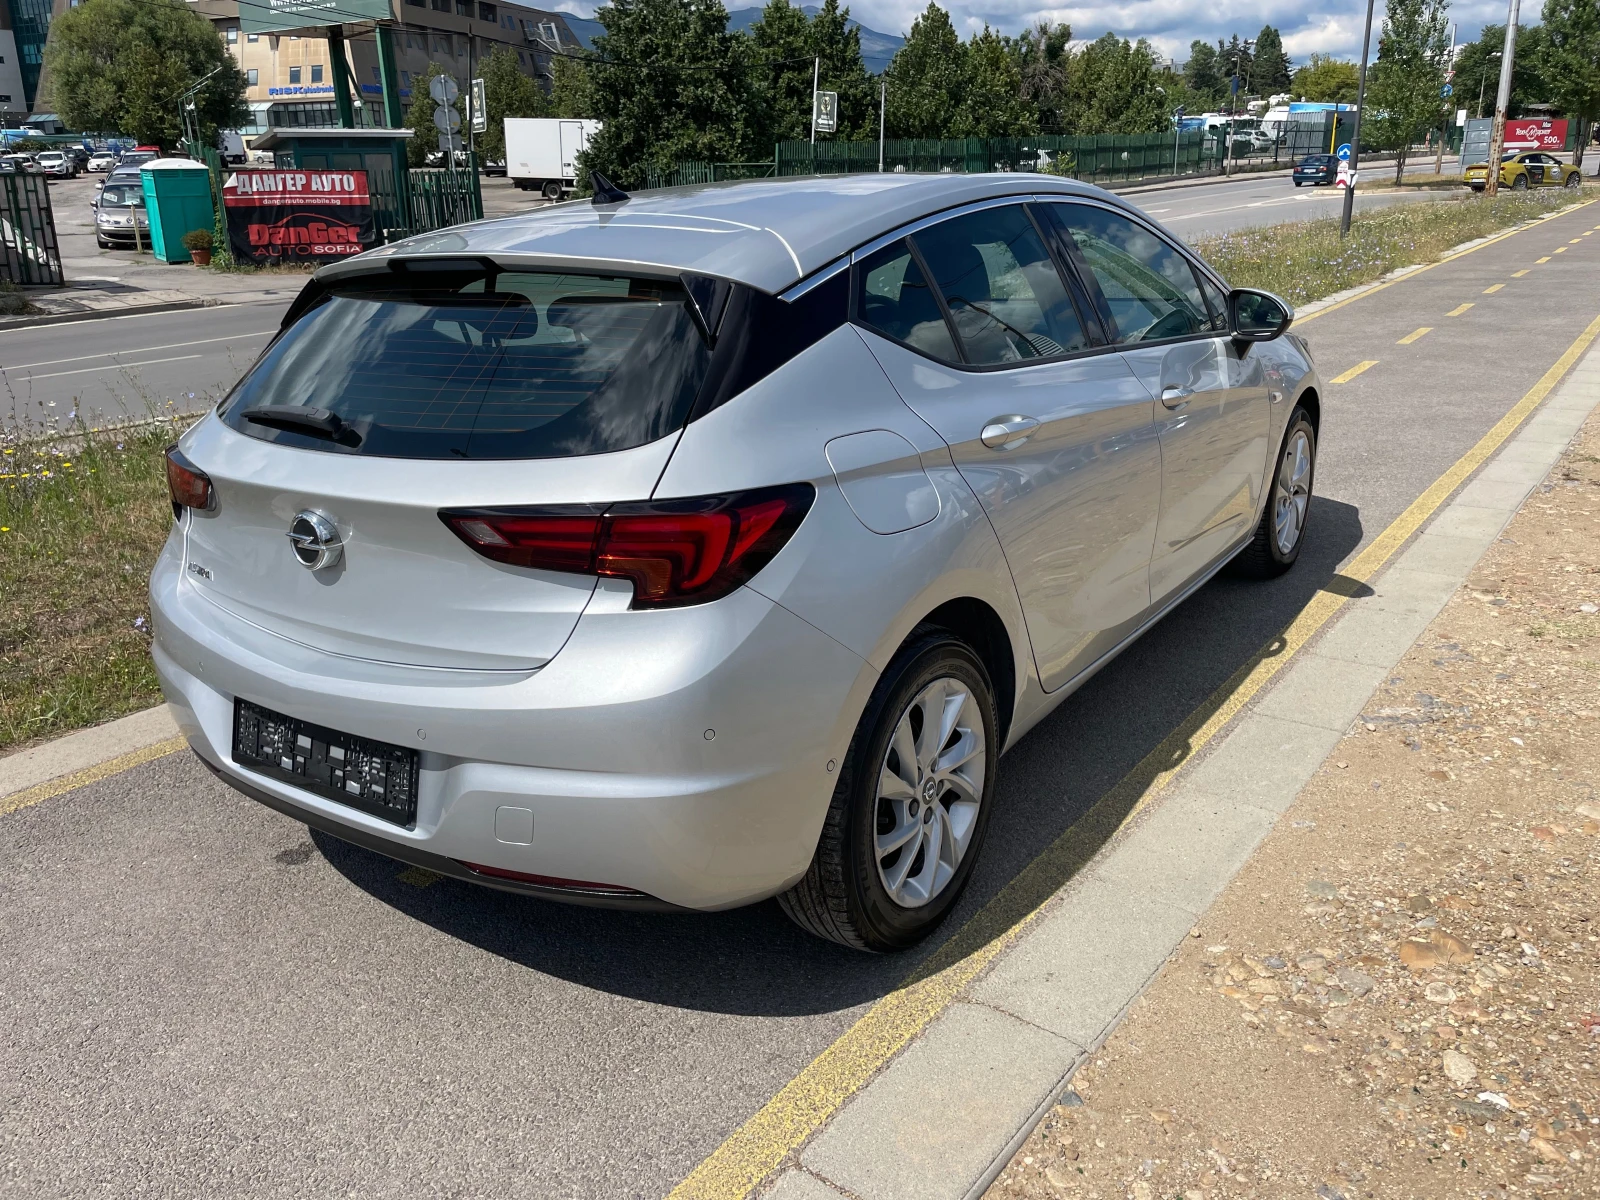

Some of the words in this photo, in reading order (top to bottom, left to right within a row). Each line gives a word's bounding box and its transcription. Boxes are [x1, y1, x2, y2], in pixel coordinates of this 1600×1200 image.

[268, 87, 303, 96] RISK
[236, 173, 307, 195] ДАНГЕР
[311, 174, 355, 192] АУТО
[262, 198, 341, 206] dangerauto.mobile.bg
[252, 246, 311, 256] AUTO
[313, 245, 361, 254] SOFIA
